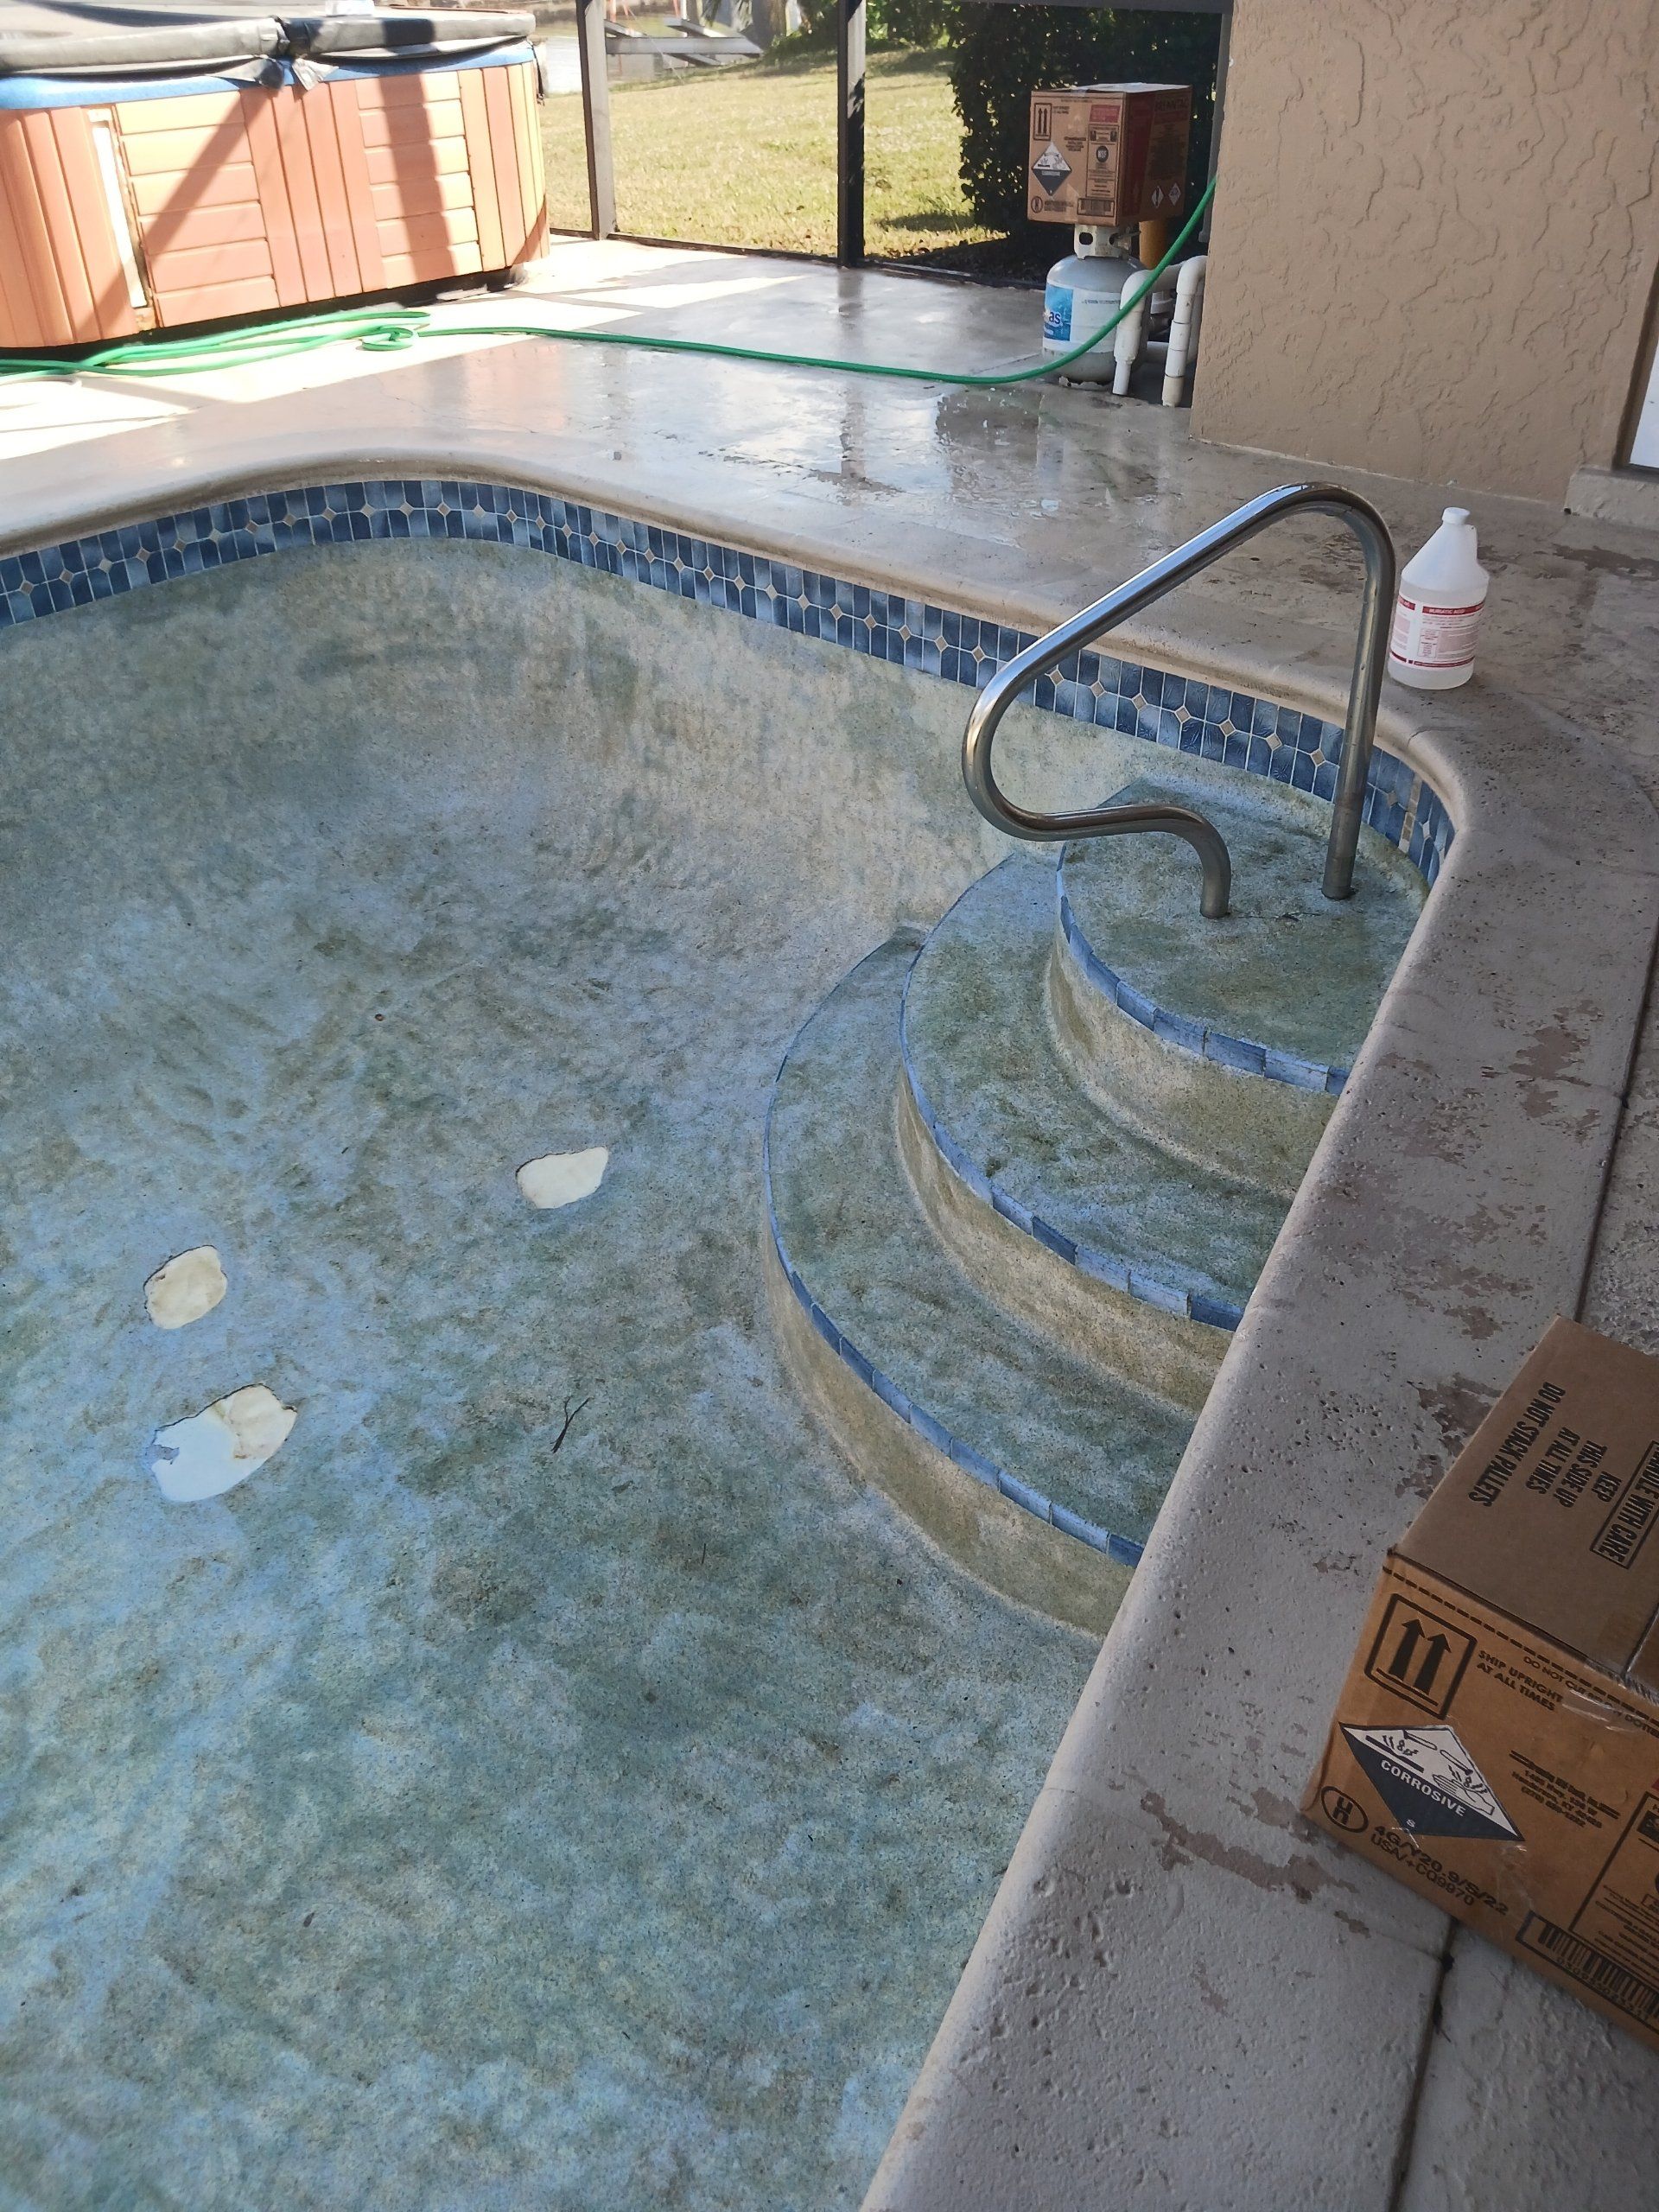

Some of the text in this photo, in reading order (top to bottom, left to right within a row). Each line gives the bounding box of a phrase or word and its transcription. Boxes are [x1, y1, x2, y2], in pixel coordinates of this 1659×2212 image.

[1468, 1382, 1566, 1507] DO NOT STACK PALLETS
[1525, 1427, 1580, 1495] AT ALL TIMES
[1553, 1440, 1608, 1509] THIS SIDE UP
[1591, 1471, 1623, 1503] KEEP
[1618, 1493, 1656, 1530] WITH
[1598, 1523, 1637, 1563] CARE
[1477, 1662, 1556, 1711] AT ALL TIMES
[1478, 1649, 1564, 1703] SHIP UPRIGHT
[1523, 1656, 1541, 1669] DO
[1542, 1666, 1565, 1683] NOT
[1381, 1759, 1467, 1817] CORROSIVE
